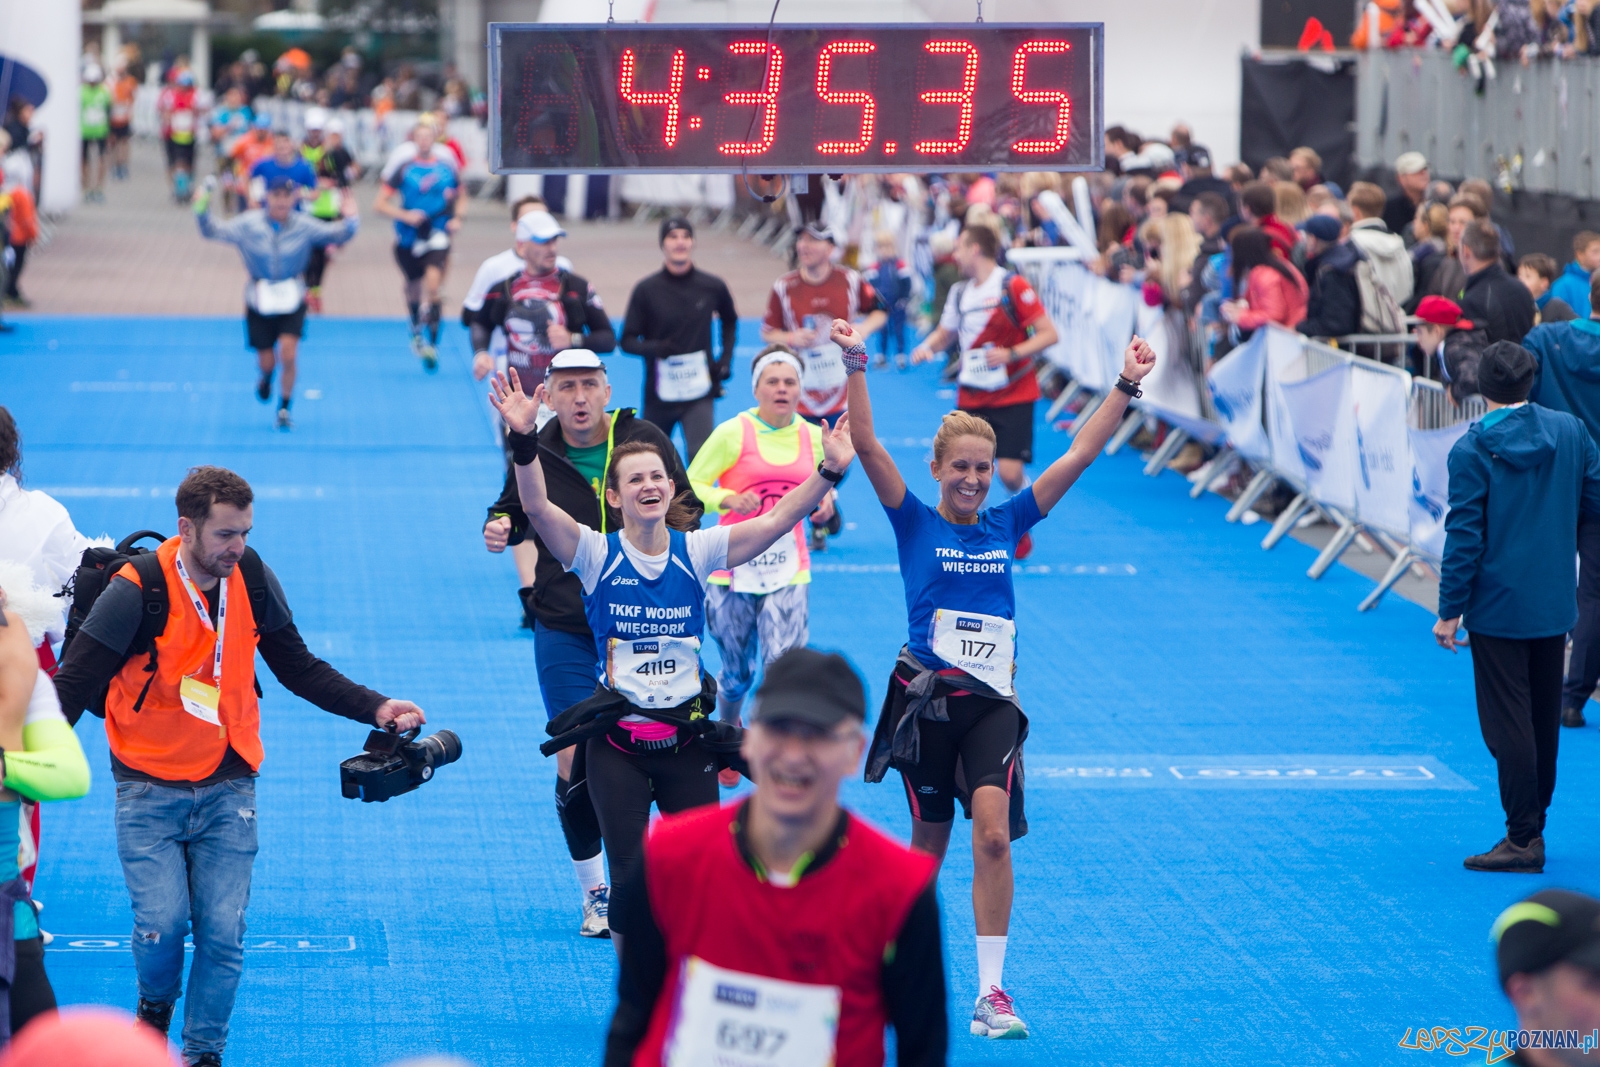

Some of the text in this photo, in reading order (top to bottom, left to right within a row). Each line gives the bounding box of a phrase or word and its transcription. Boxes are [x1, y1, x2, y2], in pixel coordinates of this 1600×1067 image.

[619, 41, 1071, 154] 4:35.35
[935, 547, 1009, 560] TKKF WODNIK
[942, 561, 1006, 575] WIĘCBORK
[608, 602, 692, 620] TKKF WODNIK
[615, 621, 686, 636] WIĘCBORK
[960, 639, 997, 659] 1177
[636, 659, 677, 676] 4119
[957, 659, 995, 672] Katarzyna
[648, 679, 670, 687] Anna
[715, 1018, 789, 1060] 697
